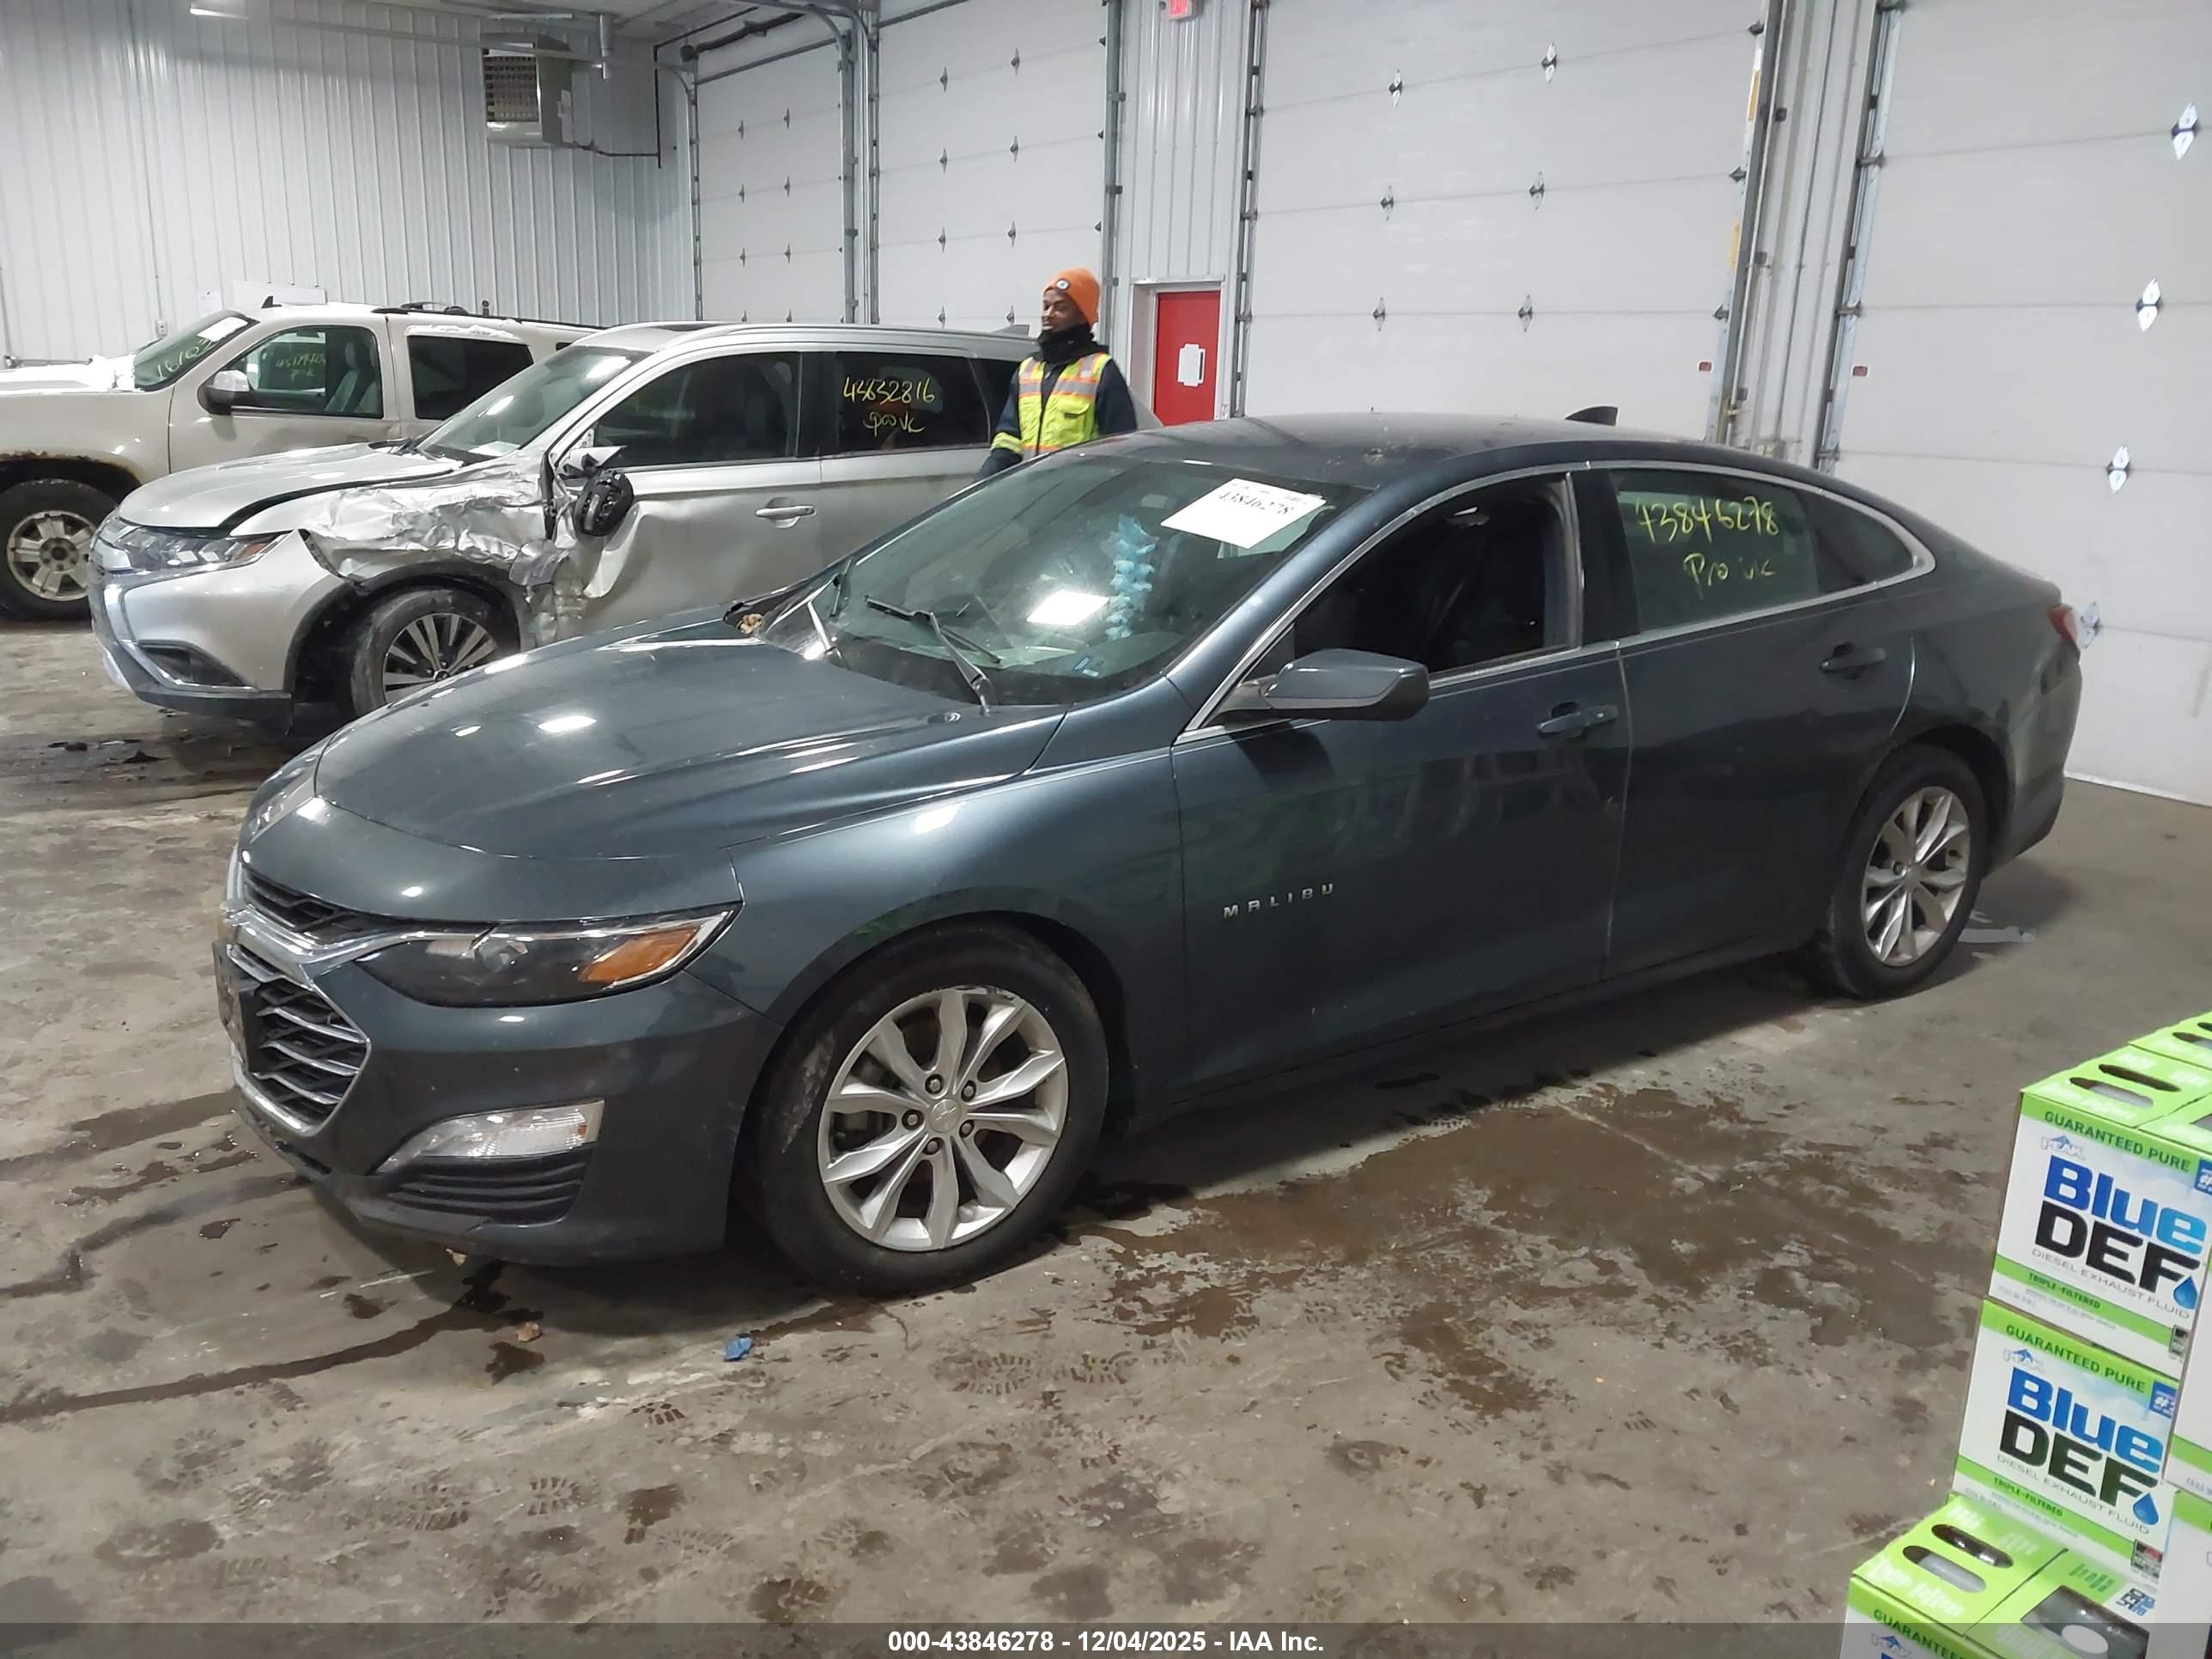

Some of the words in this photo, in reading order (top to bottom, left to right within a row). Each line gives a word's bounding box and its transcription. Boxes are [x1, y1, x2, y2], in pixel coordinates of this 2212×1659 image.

[1224, 884, 1333, 919] MALIBU
[2045, 1111, 2143, 1155] GUARANTEED
[2148, 1147, 2190, 1173] PURE
[2044, 1154, 2207, 1255] Blue
[2032, 1248, 2076, 1273] DIESEL
[2081, 1268, 2146, 1300] EXHAUST
[2148, 1297, 2190, 1319] FLUID
[2035, 1200, 2200, 1293] DEF
[2006, 1324, 2100, 1372] GUARANTEED
[2105, 1366, 2146, 1394] PURE
[2008, 1366, 2163, 1473] Blue
[1997, 1455, 2039, 1480] DIESEL
[2044, 1477, 2103, 1511] EXHAUST
[2109, 1510, 2149, 1534] FLUID
[2000, 1409, 2158, 1507] DEF
[1874, 1608, 1965, 1659] GUARANTEE
